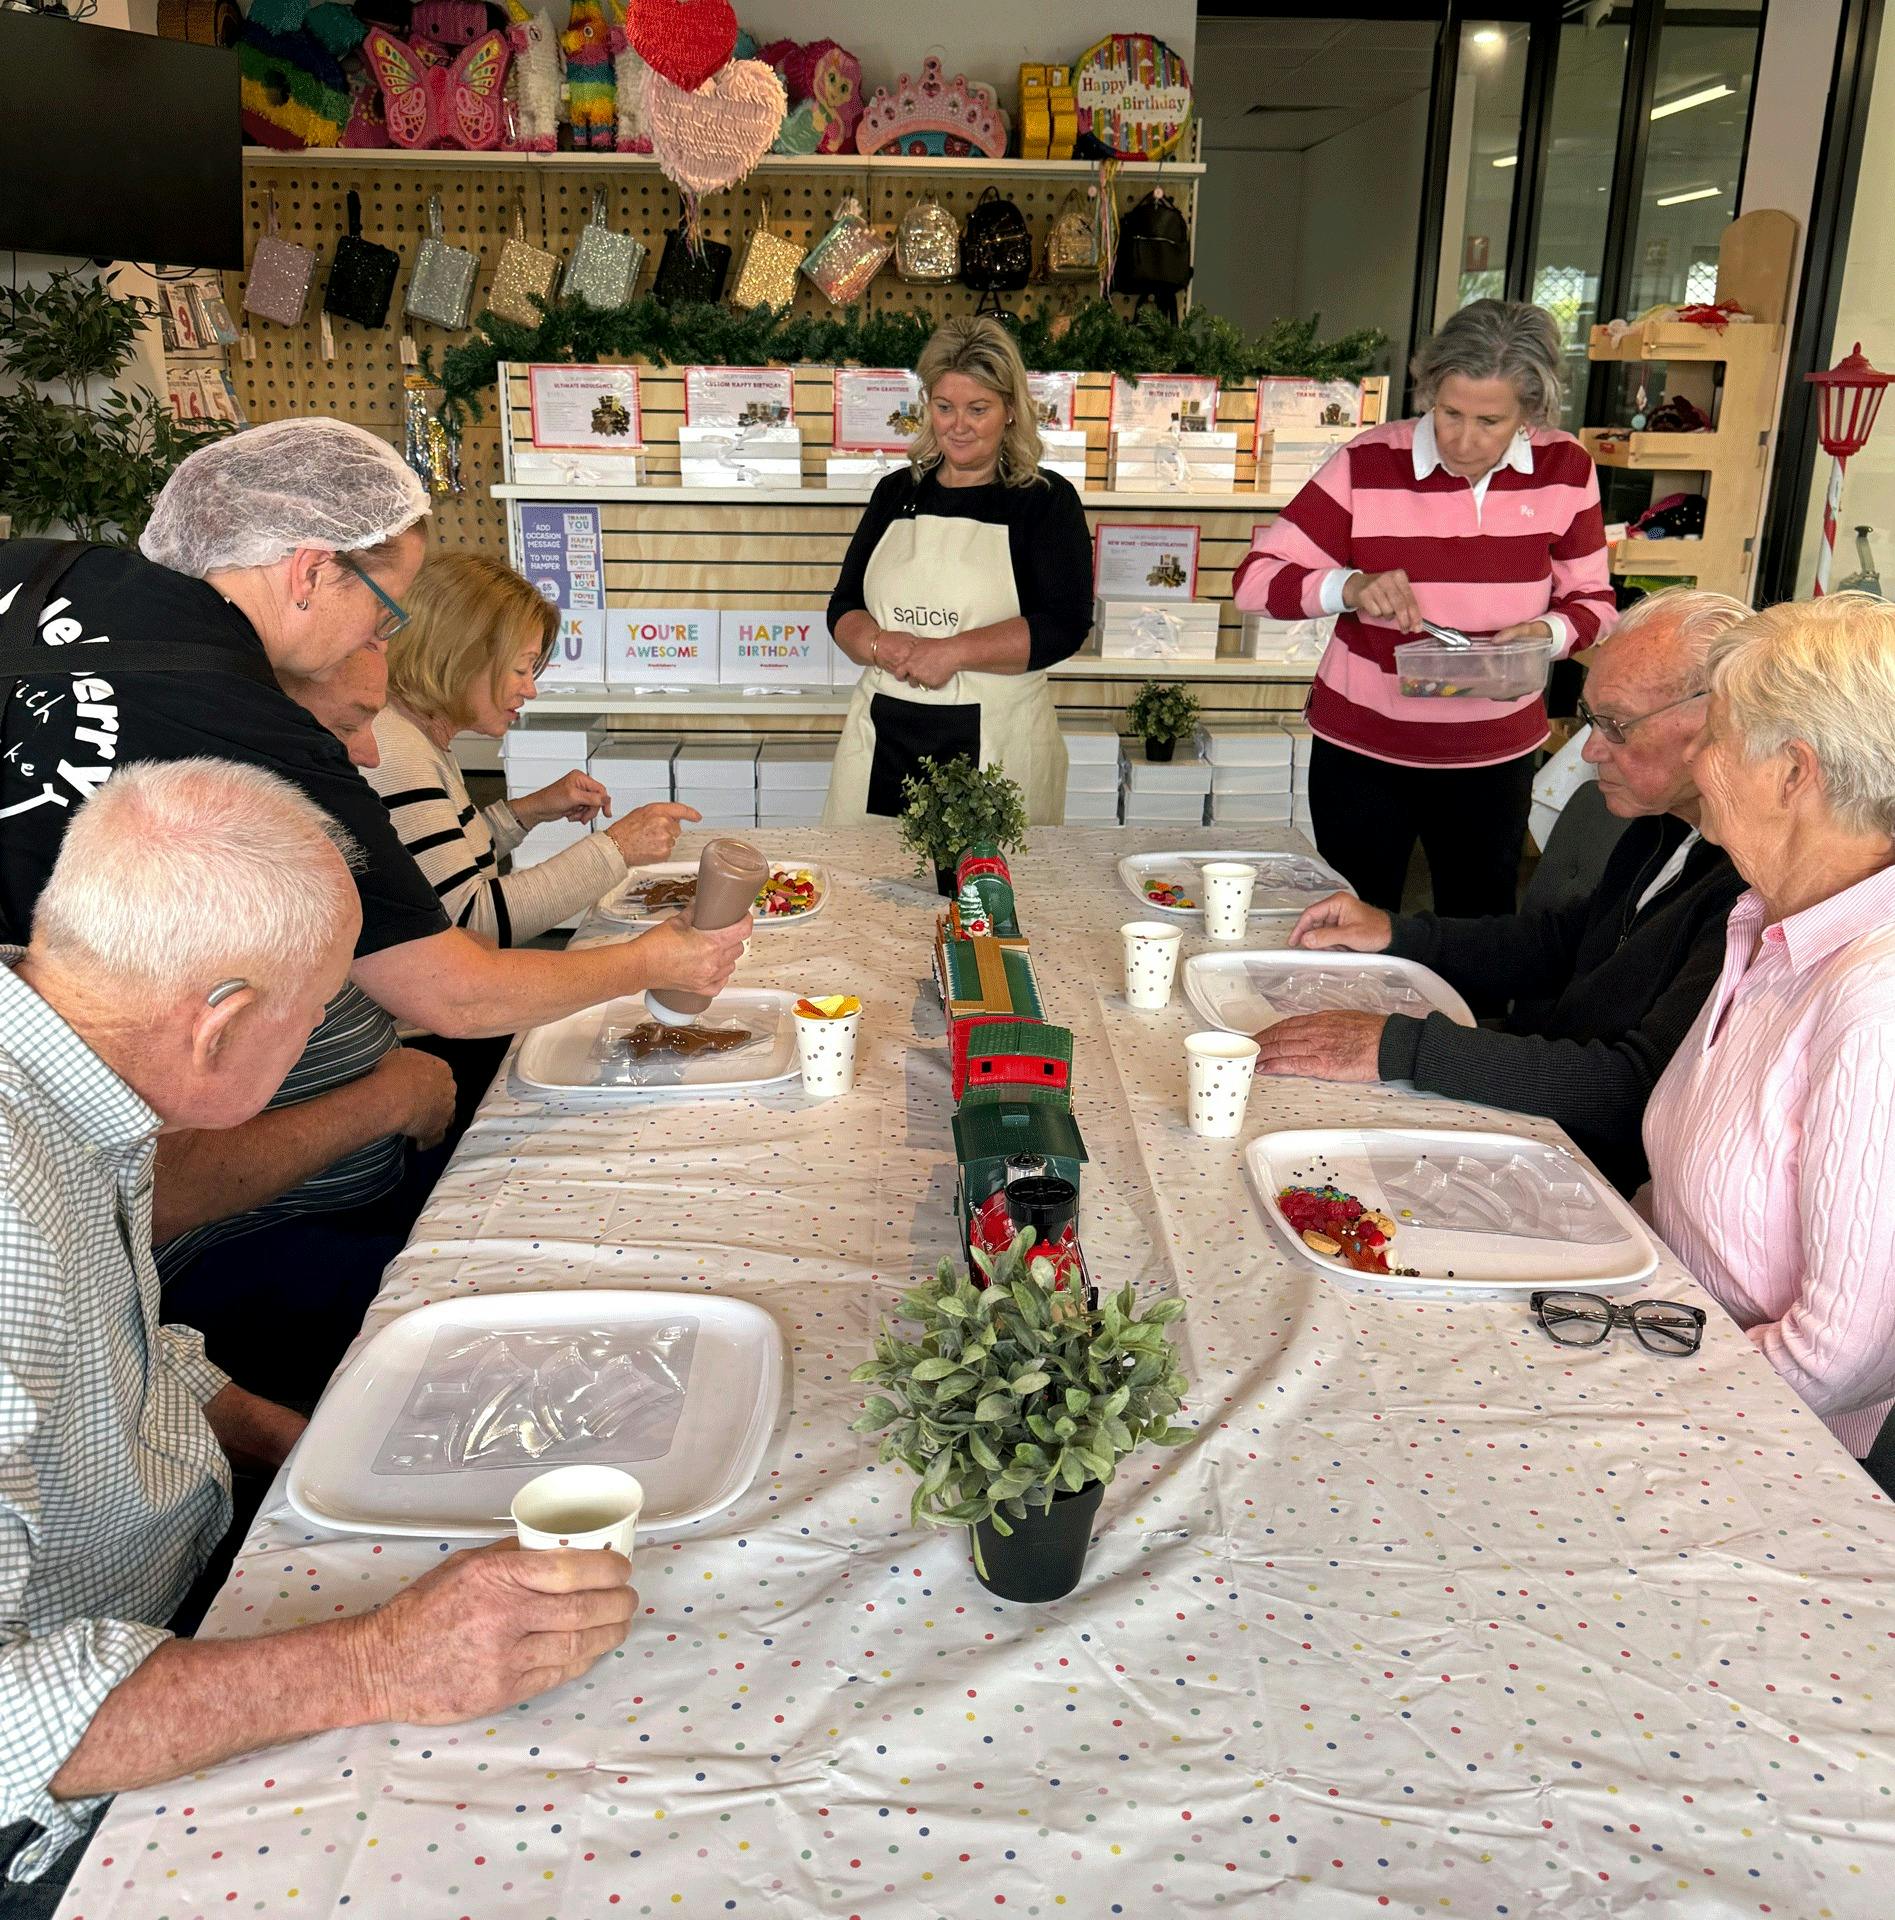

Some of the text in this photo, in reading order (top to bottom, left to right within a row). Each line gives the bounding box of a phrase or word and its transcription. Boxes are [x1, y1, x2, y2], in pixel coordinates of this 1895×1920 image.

[1082, 77, 1126, 94] Happy
[1122, 95, 1185, 112] Birthday
[568, 521, 590, 529] YOU
[525, 532, 561, 540] OCCASION
[527, 540, 561, 548] MESSAGE
[530, 562, 561, 570] HAMPER
[627, 624, 698, 641] YOU'RE
[739, 625, 810, 641] HAPPY
[625, 646, 698, 658] AWESOME
[738, 645, 810, 657] BIRTHDAY
